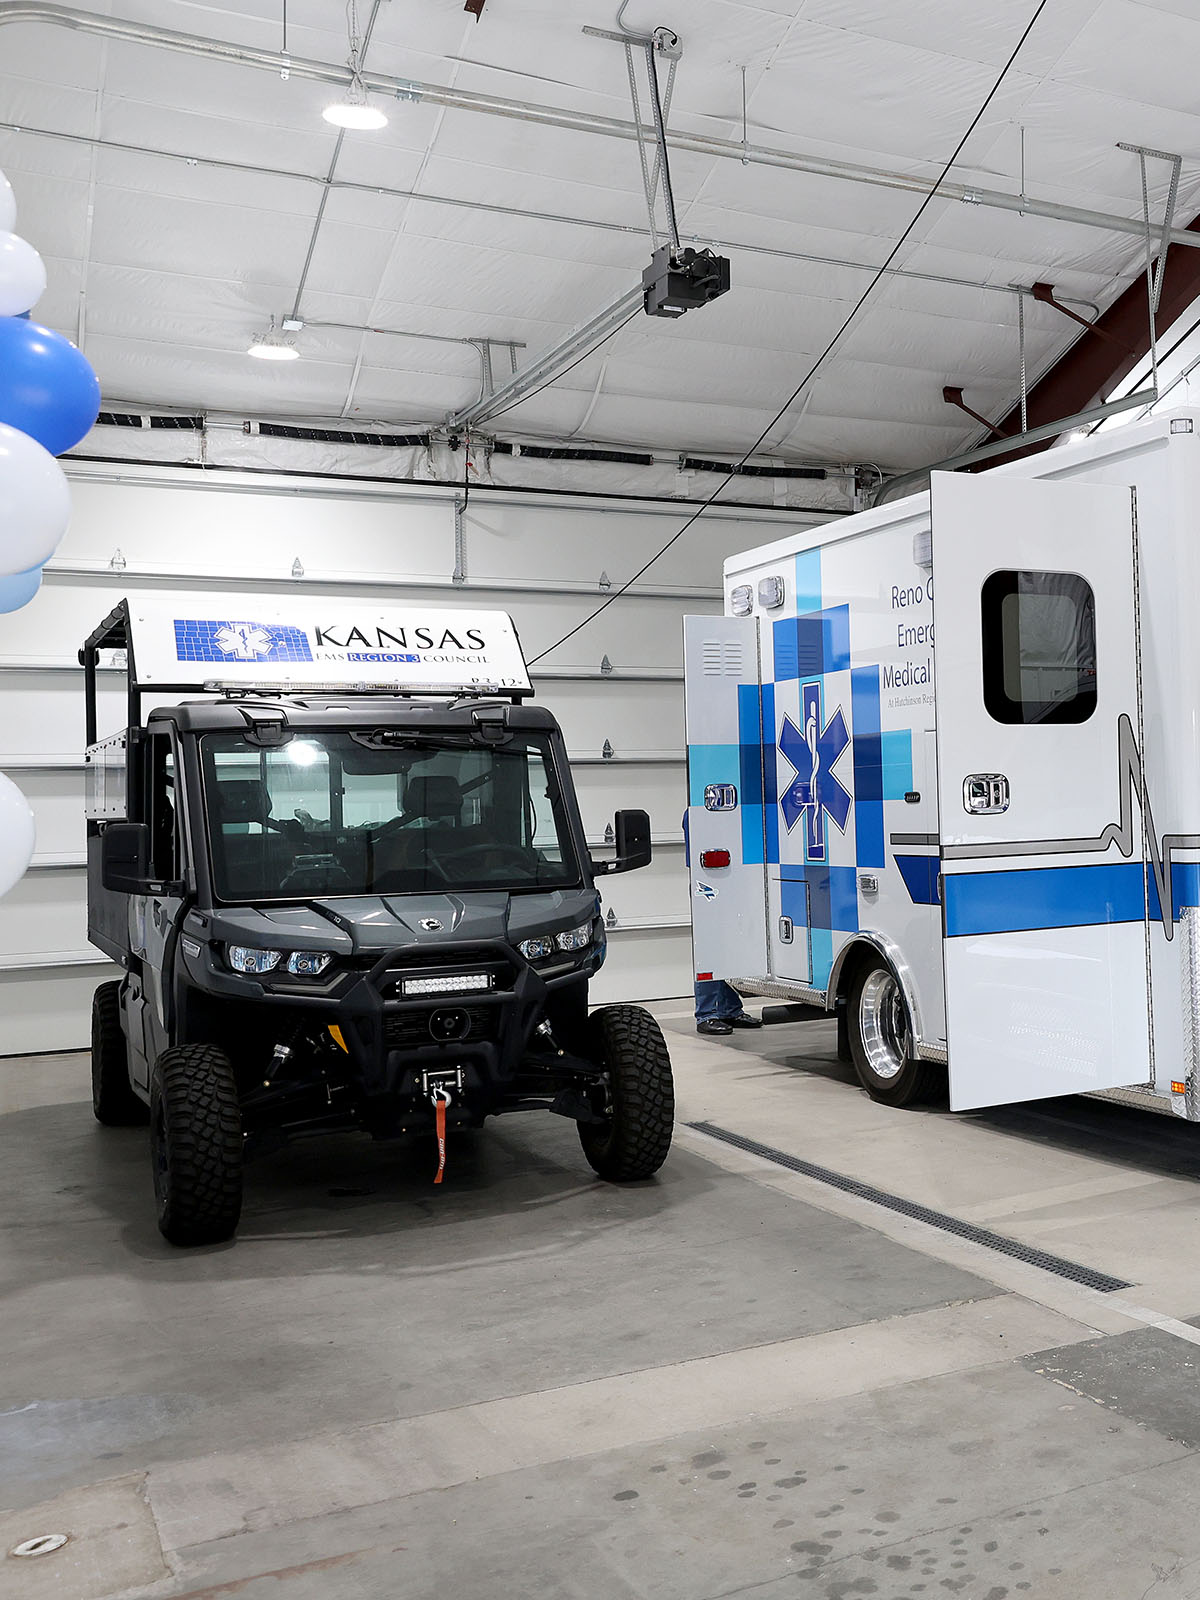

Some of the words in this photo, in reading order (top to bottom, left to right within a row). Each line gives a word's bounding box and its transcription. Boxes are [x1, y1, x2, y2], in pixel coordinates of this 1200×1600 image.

[891, 585, 924, 609] Reno
[314, 625, 486, 650] KANSAS
[316, 652, 345, 661] EMS
[349, 653, 407, 662] REGION
[410, 654, 419, 662] 3
[423, 655, 490, 663] COUNCIL
[883, 657, 931, 689] Medical
